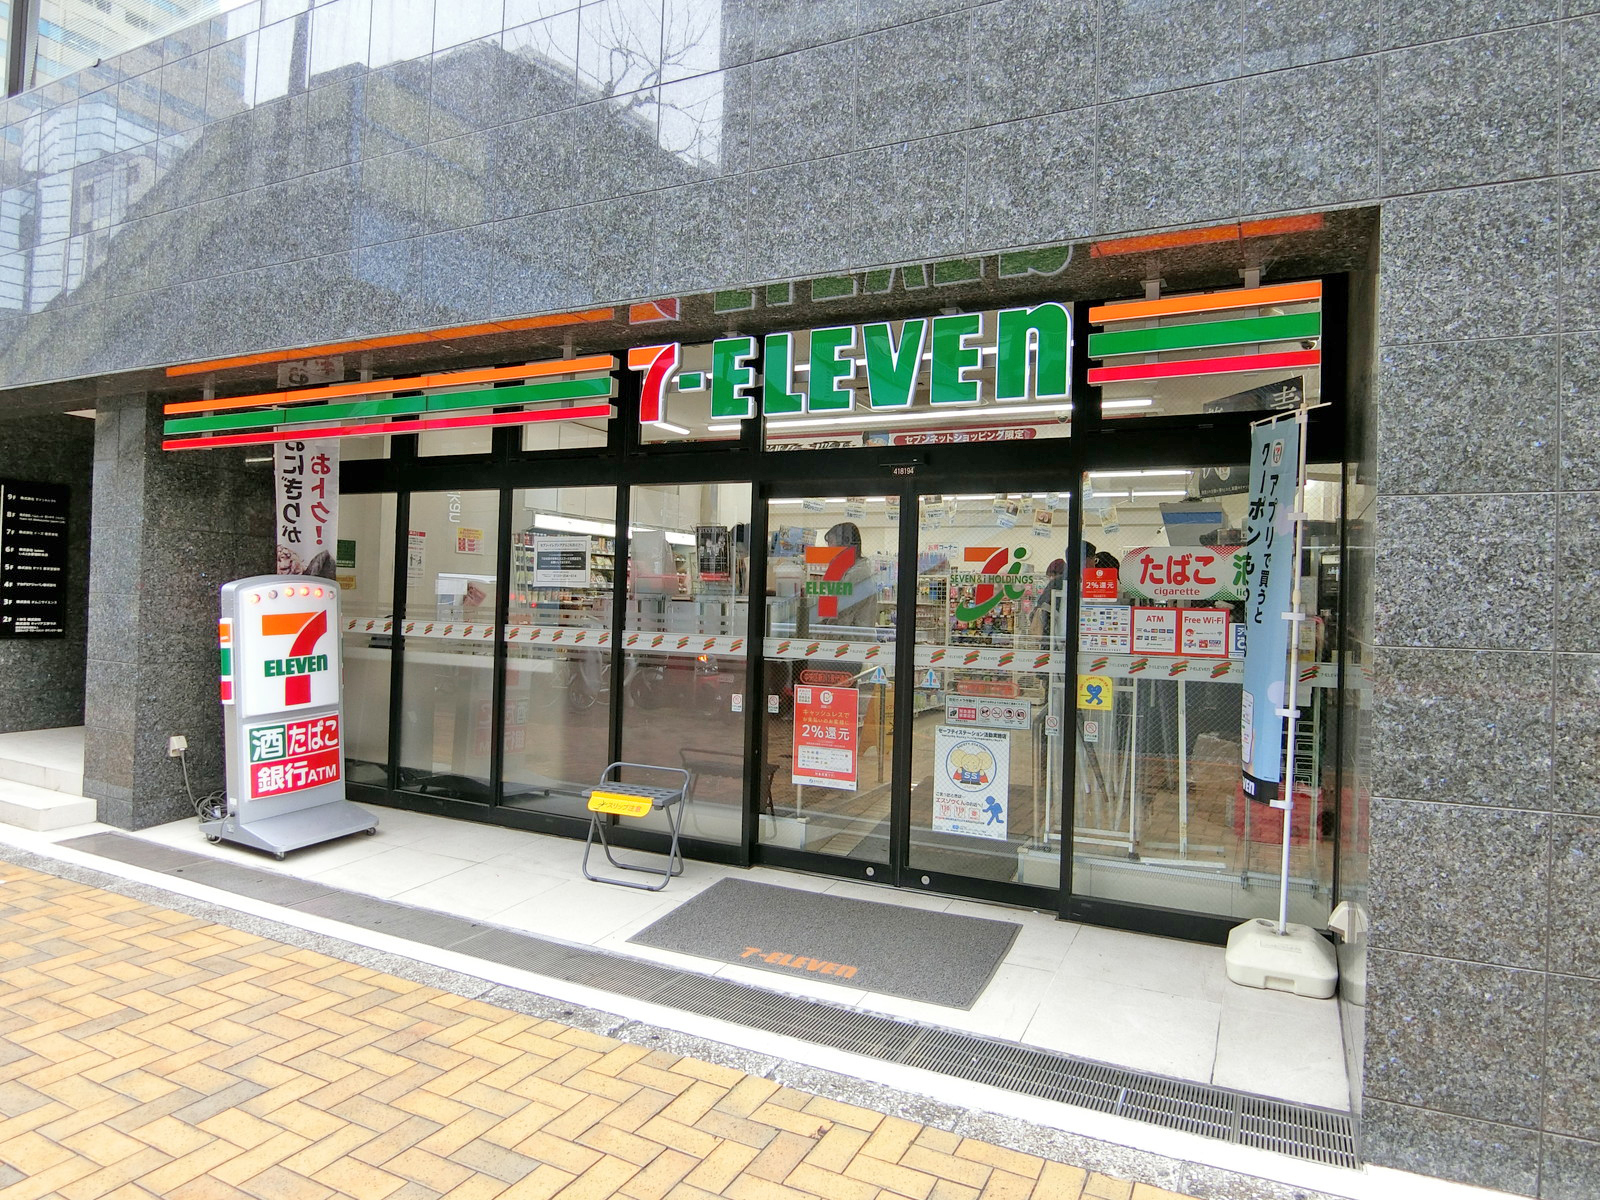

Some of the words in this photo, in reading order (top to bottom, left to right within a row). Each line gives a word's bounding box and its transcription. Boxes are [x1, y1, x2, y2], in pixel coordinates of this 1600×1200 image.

[893, 467, 914, 475] 418194
[1254, 474, 1279, 624] アプリで買うと
[1140, 553, 1216, 585] たばこ
[988, 575, 1034, 585] HOLDINGS
[1154, 588, 1200, 597] cigarette
[1145, 615, 1165, 623] ATM
[1184, 616, 1202, 624] Free
[1202, 616, 1224, 625] Wi-Fi
[801, 724, 850, 740] 2%還元
[252, 729, 284, 762] 酒
[288, 719, 339, 752] たばこ
